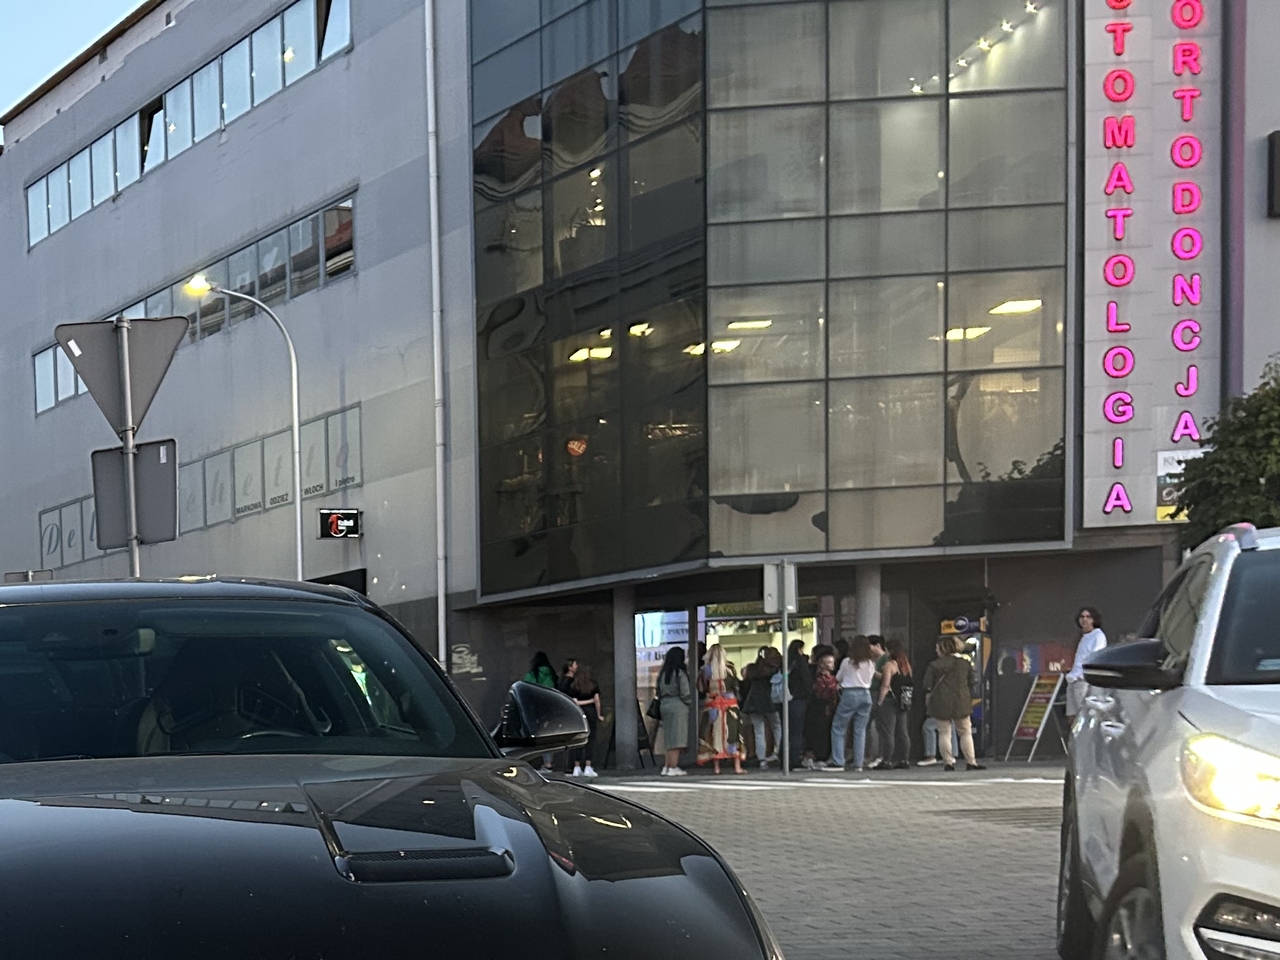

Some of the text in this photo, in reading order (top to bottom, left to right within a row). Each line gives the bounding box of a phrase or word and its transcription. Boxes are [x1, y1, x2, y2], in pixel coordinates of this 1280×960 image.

[1171, 0, 1204, 443] ORTODONCJA
[236, 501, 262, 514] MARKOWA
[269, 492, 289, 506] ODZIEŻ
